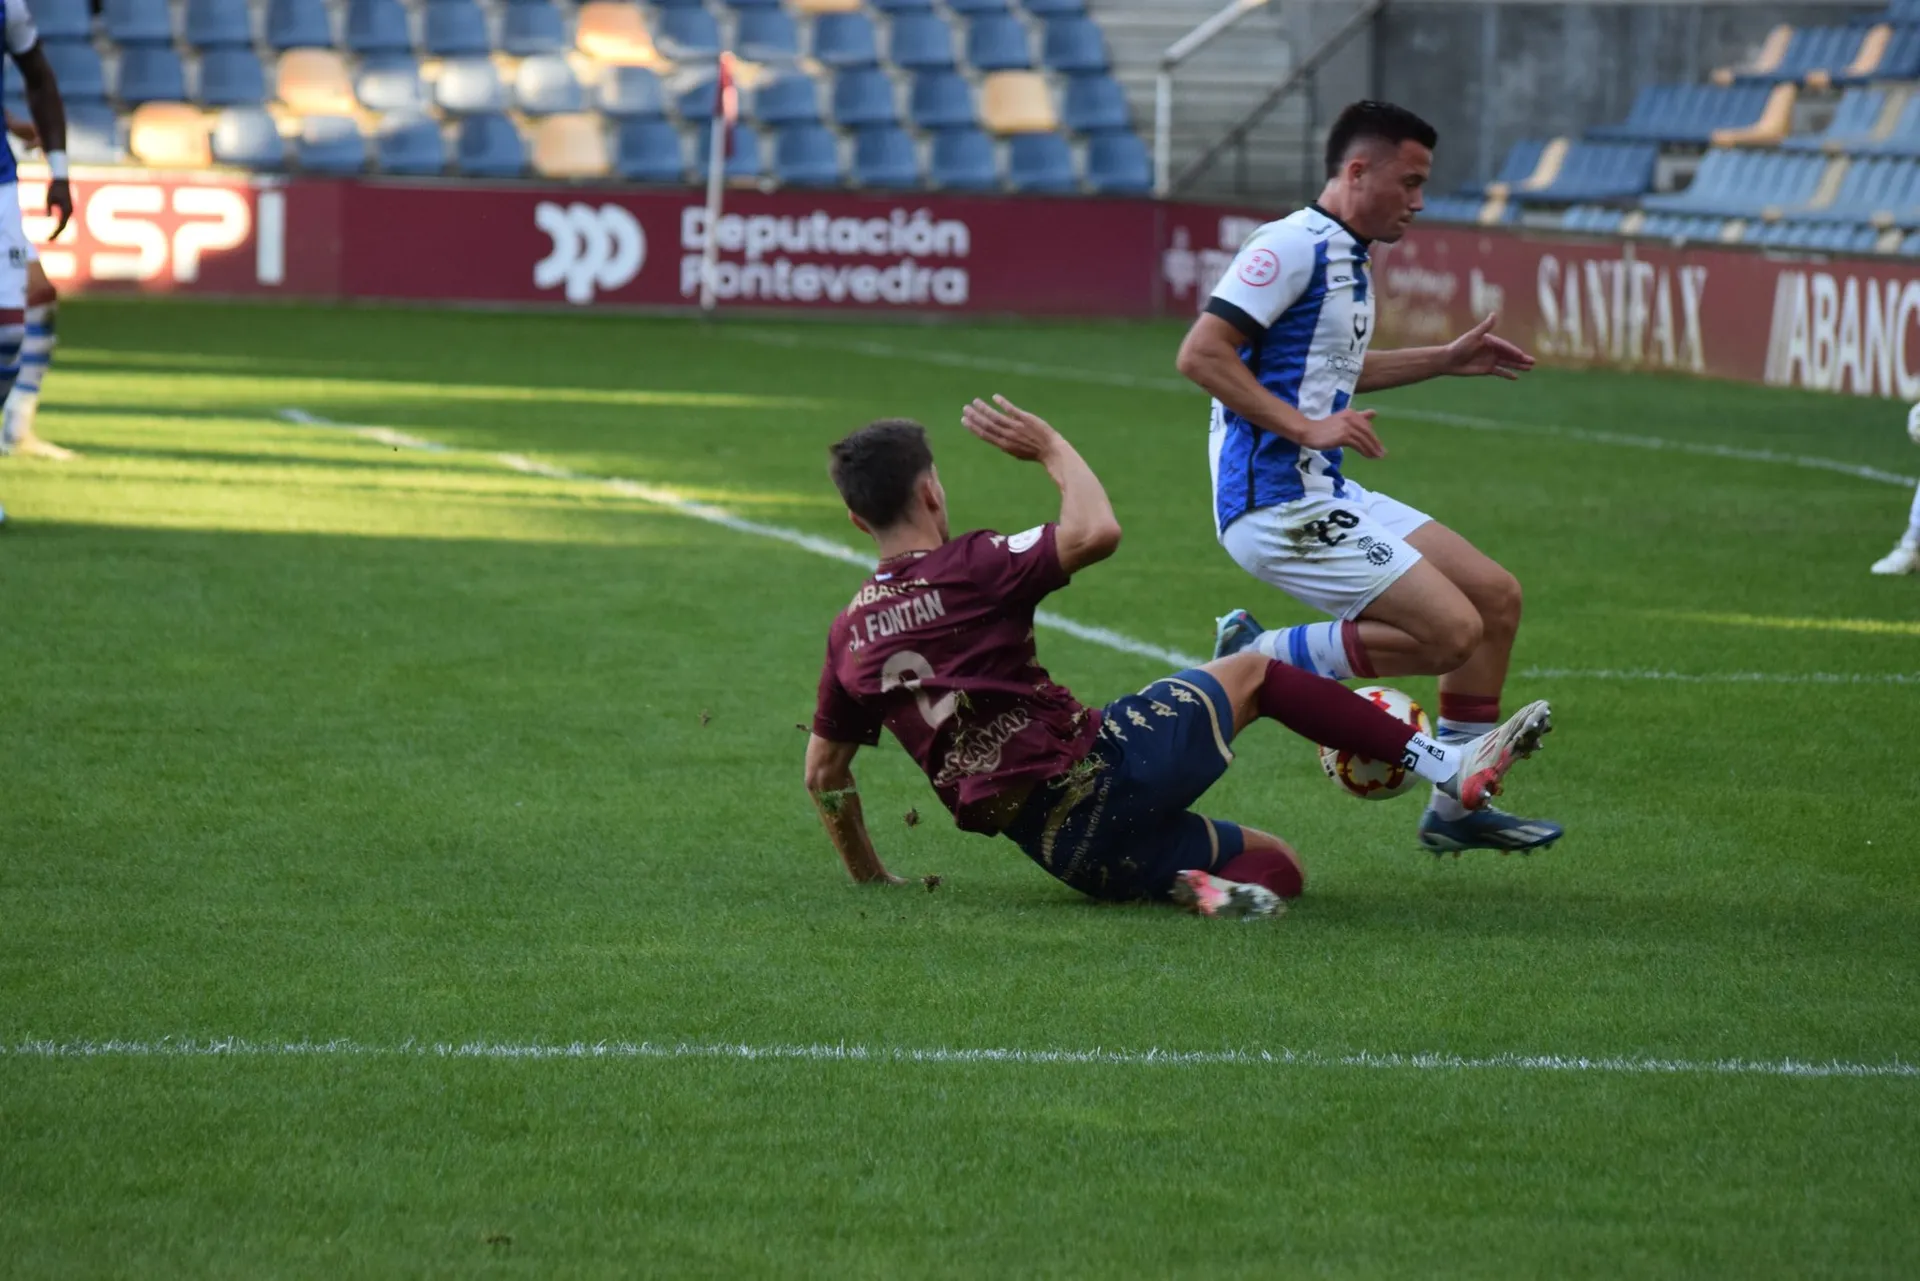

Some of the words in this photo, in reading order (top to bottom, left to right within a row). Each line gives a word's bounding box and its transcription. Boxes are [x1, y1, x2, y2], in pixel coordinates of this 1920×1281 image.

[681, 205, 970, 261] Deputación
[680, 253, 969, 305] Pontevedra
[1764, 269, 1920, 402] ABANC
[865, 589, 946, 643] FONTAN
[932, 707, 1033, 788] SCAMAR
